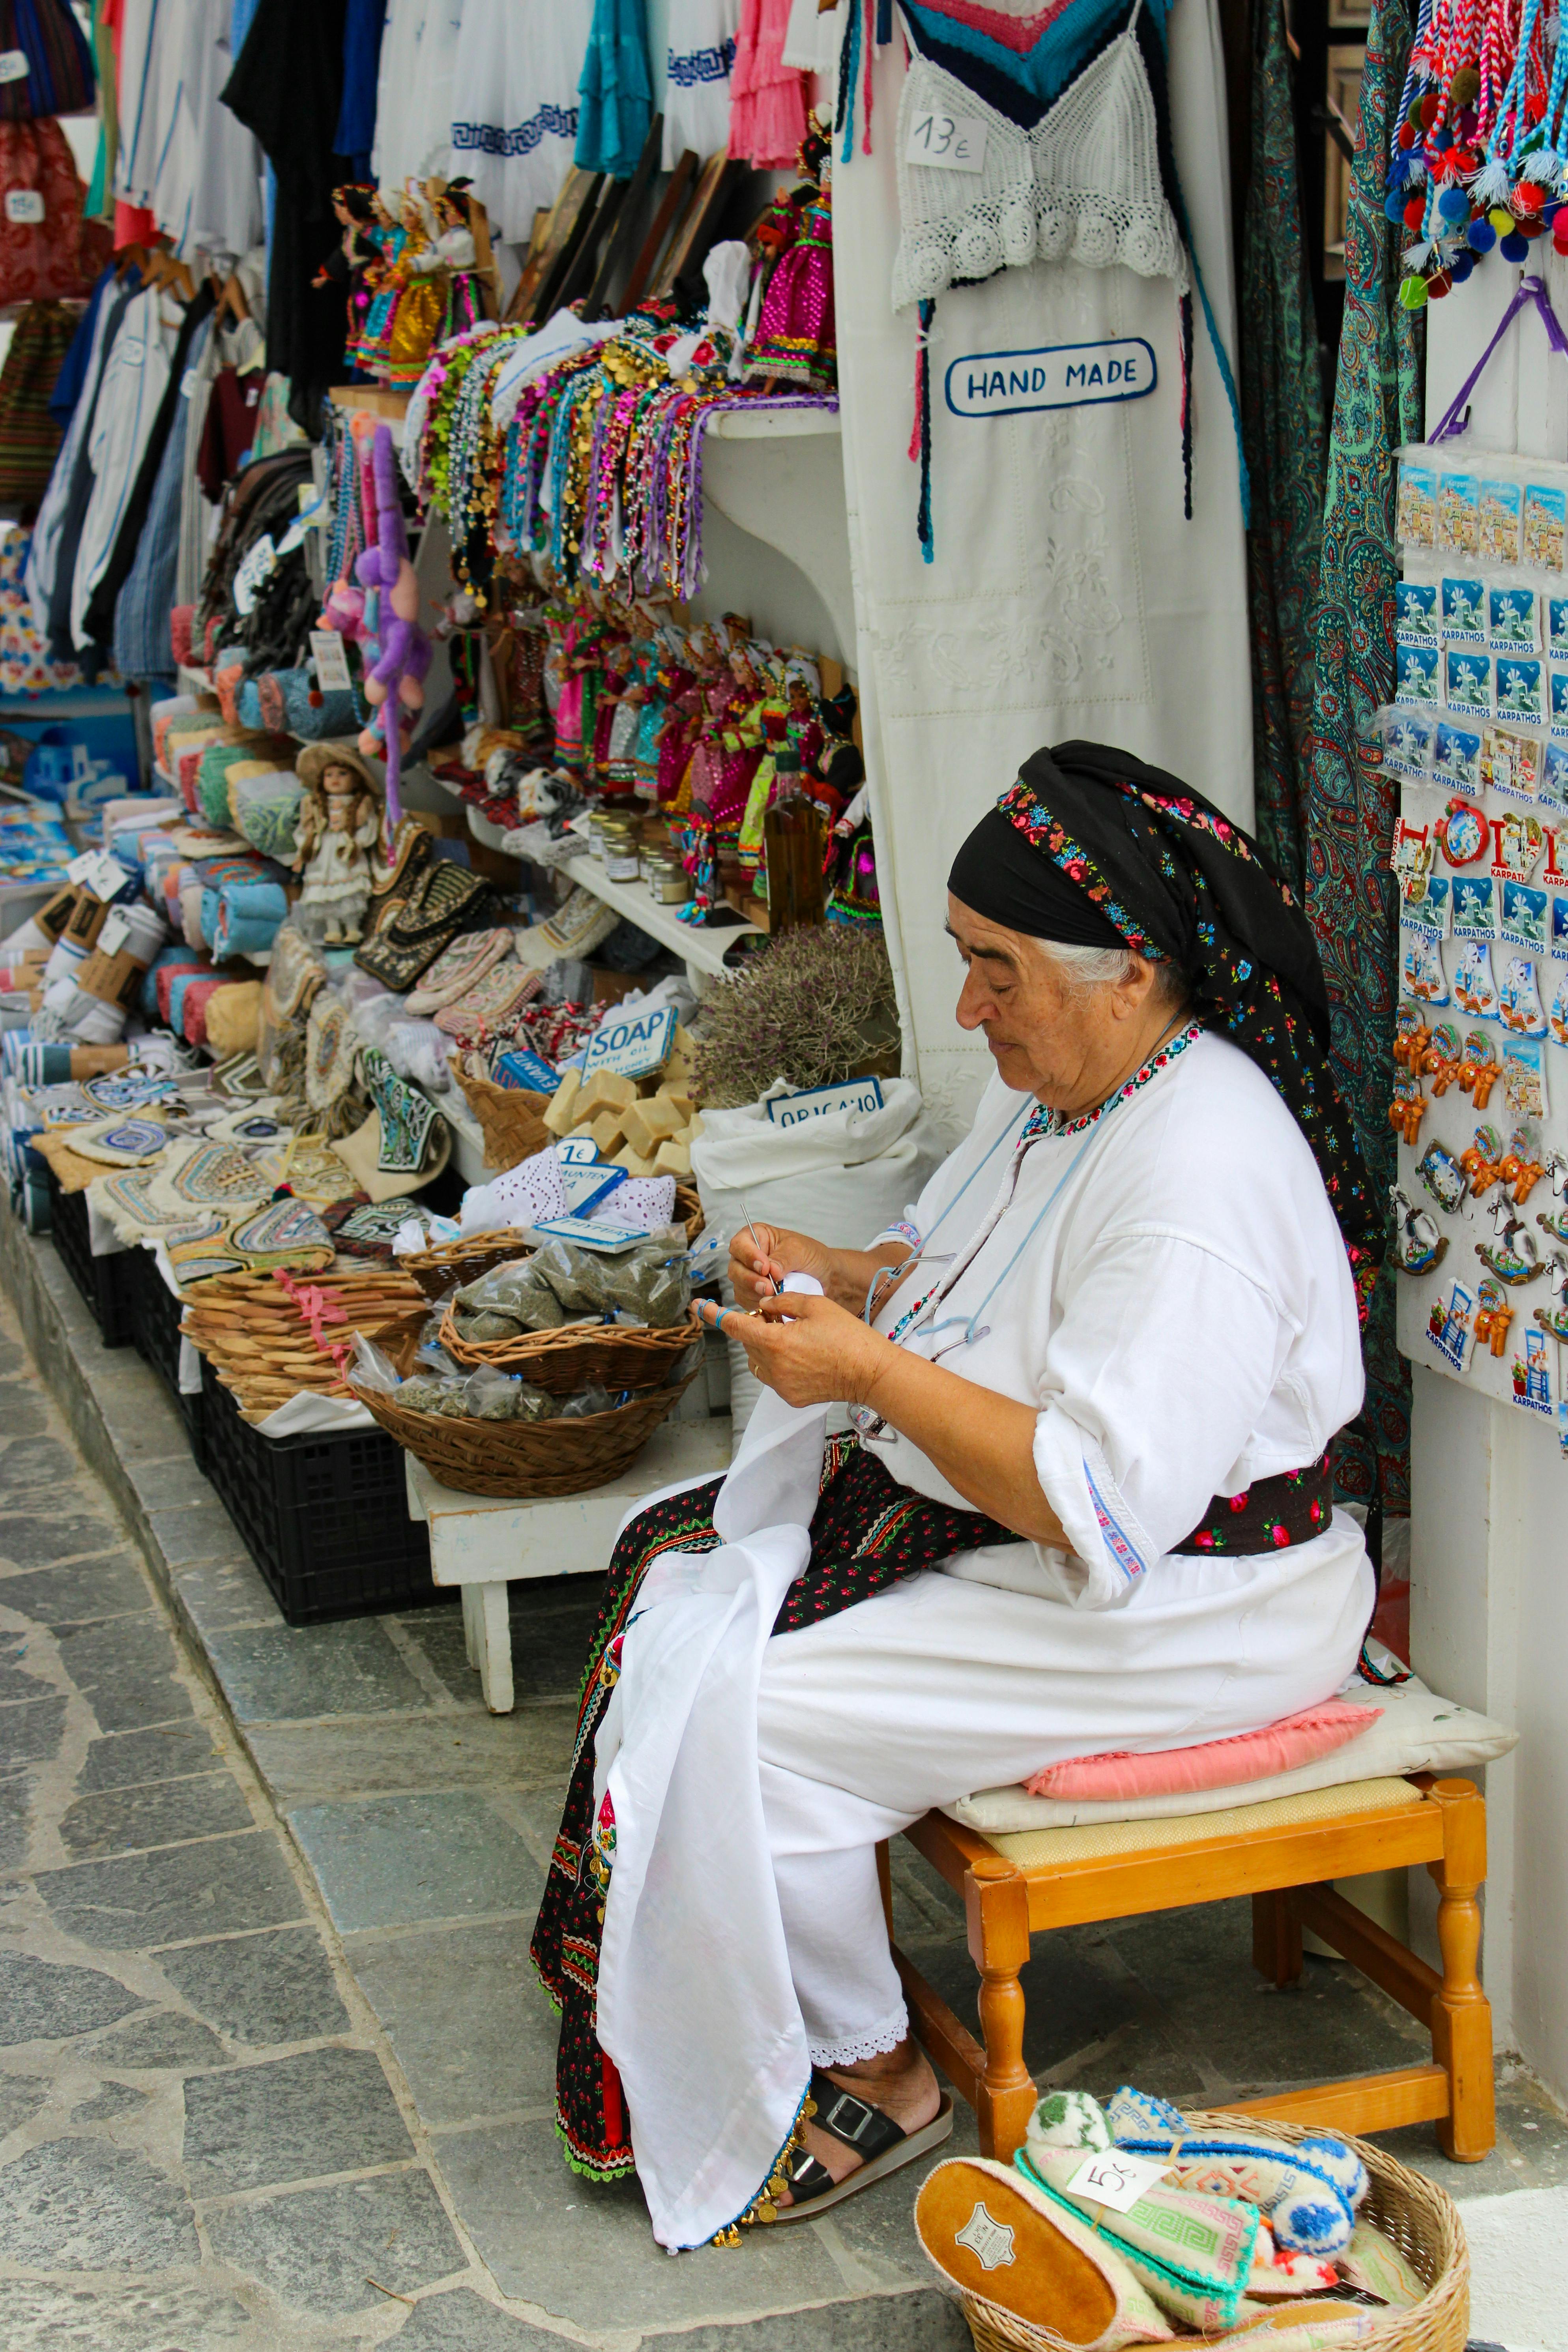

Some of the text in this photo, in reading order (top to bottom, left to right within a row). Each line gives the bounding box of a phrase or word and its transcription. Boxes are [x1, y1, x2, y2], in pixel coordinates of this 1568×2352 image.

[968, 359, 1137, 400] HAND MADE
[1396, 631, 1438, 647] KARPATHOS
[1442, 630, 1485, 643] KARPATHOS
[1489, 640, 1534, 653] KARPATHOS
[1396, 694, 1438, 708] KARPAOS
[1448, 702, 1490, 719] KARPATHOS
[1497, 710, 1542, 724] KARPATHOS
[1385, 756, 1427, 778] KARPATHOS
[1432, 771, 1476, 796] KARPATHOS
[1494, 782, 1533, 804] KARPATHOS
[1400, 917, 1443, 939] KARPATHOS
[1453, 926, 1495, 939] KARPATHOS
[1501, 930, 1545, 954] KARPATHOS
[592, 1011, 665, 1057] SOAP
[587, 1054, 621, 1068] WITH
[615, 1056, 651, 1074] HONEY
[563, 1145, 584, 1162] 1€
[560, 1220, 635, 1238] THYMIAN
[1425, 1328, 1462, 1372] KARPATHOS
[1512, 1393, 1553, 1415] KARPATHOS
[975, 2225, 982, 2233] UK
[974, 2233, 983, 2244] 33
